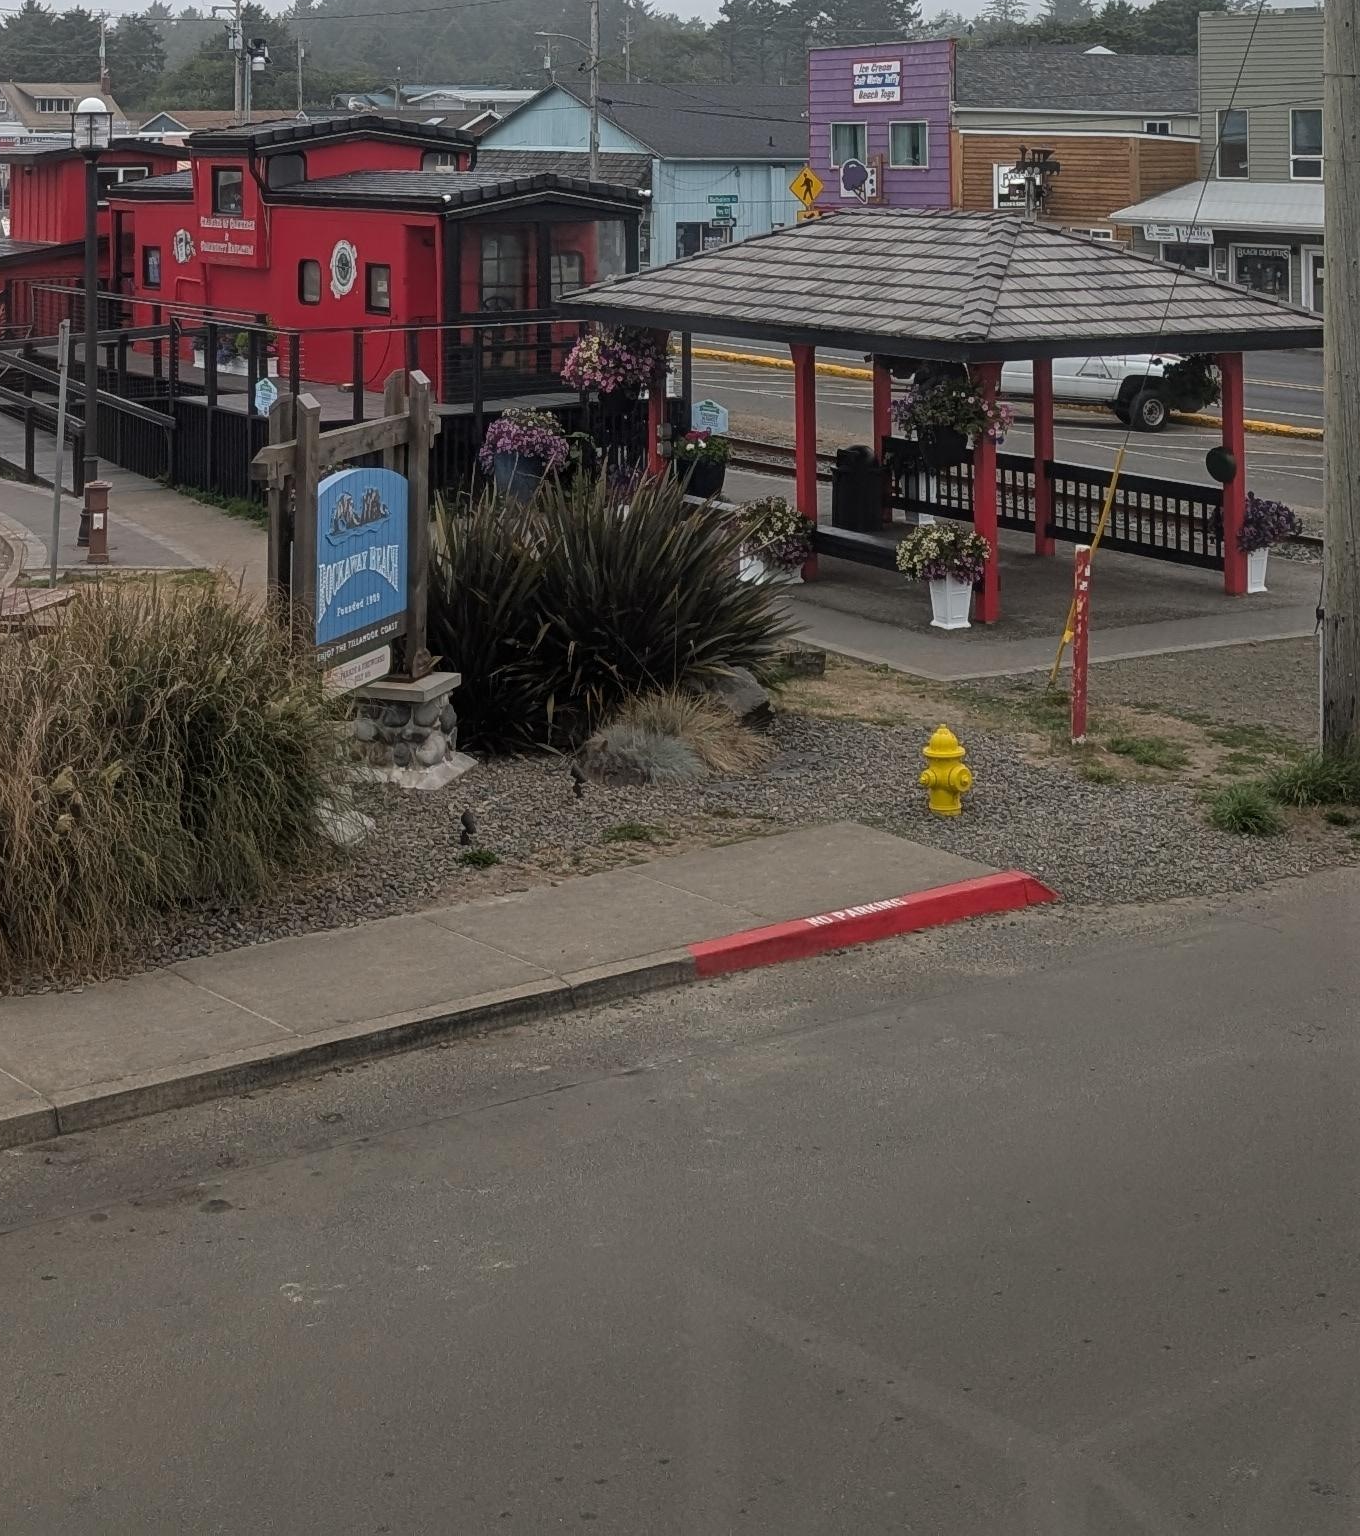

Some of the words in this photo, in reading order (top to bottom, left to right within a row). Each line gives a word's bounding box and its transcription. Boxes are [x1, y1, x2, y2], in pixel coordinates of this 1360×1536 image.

[859, 65, 869, 73] Ice
[871, 63, 892, 72] Cream
[859, 90, 879, 100] Beach
[881, 89, 896, 100] Toys
[317, 550, 369, 624] ROCKAWAY
[368, 544, 400, 593] BEACH
[336, 598, 365, 617] Founded
[336, 642, 347, 655] THE
[347, 628, 379, 650] TILLAMOOK
[380, 620, 399, 636] COAST
[803, 915, 834, 928] NO
[831, 897, 909, 921] PARKING
